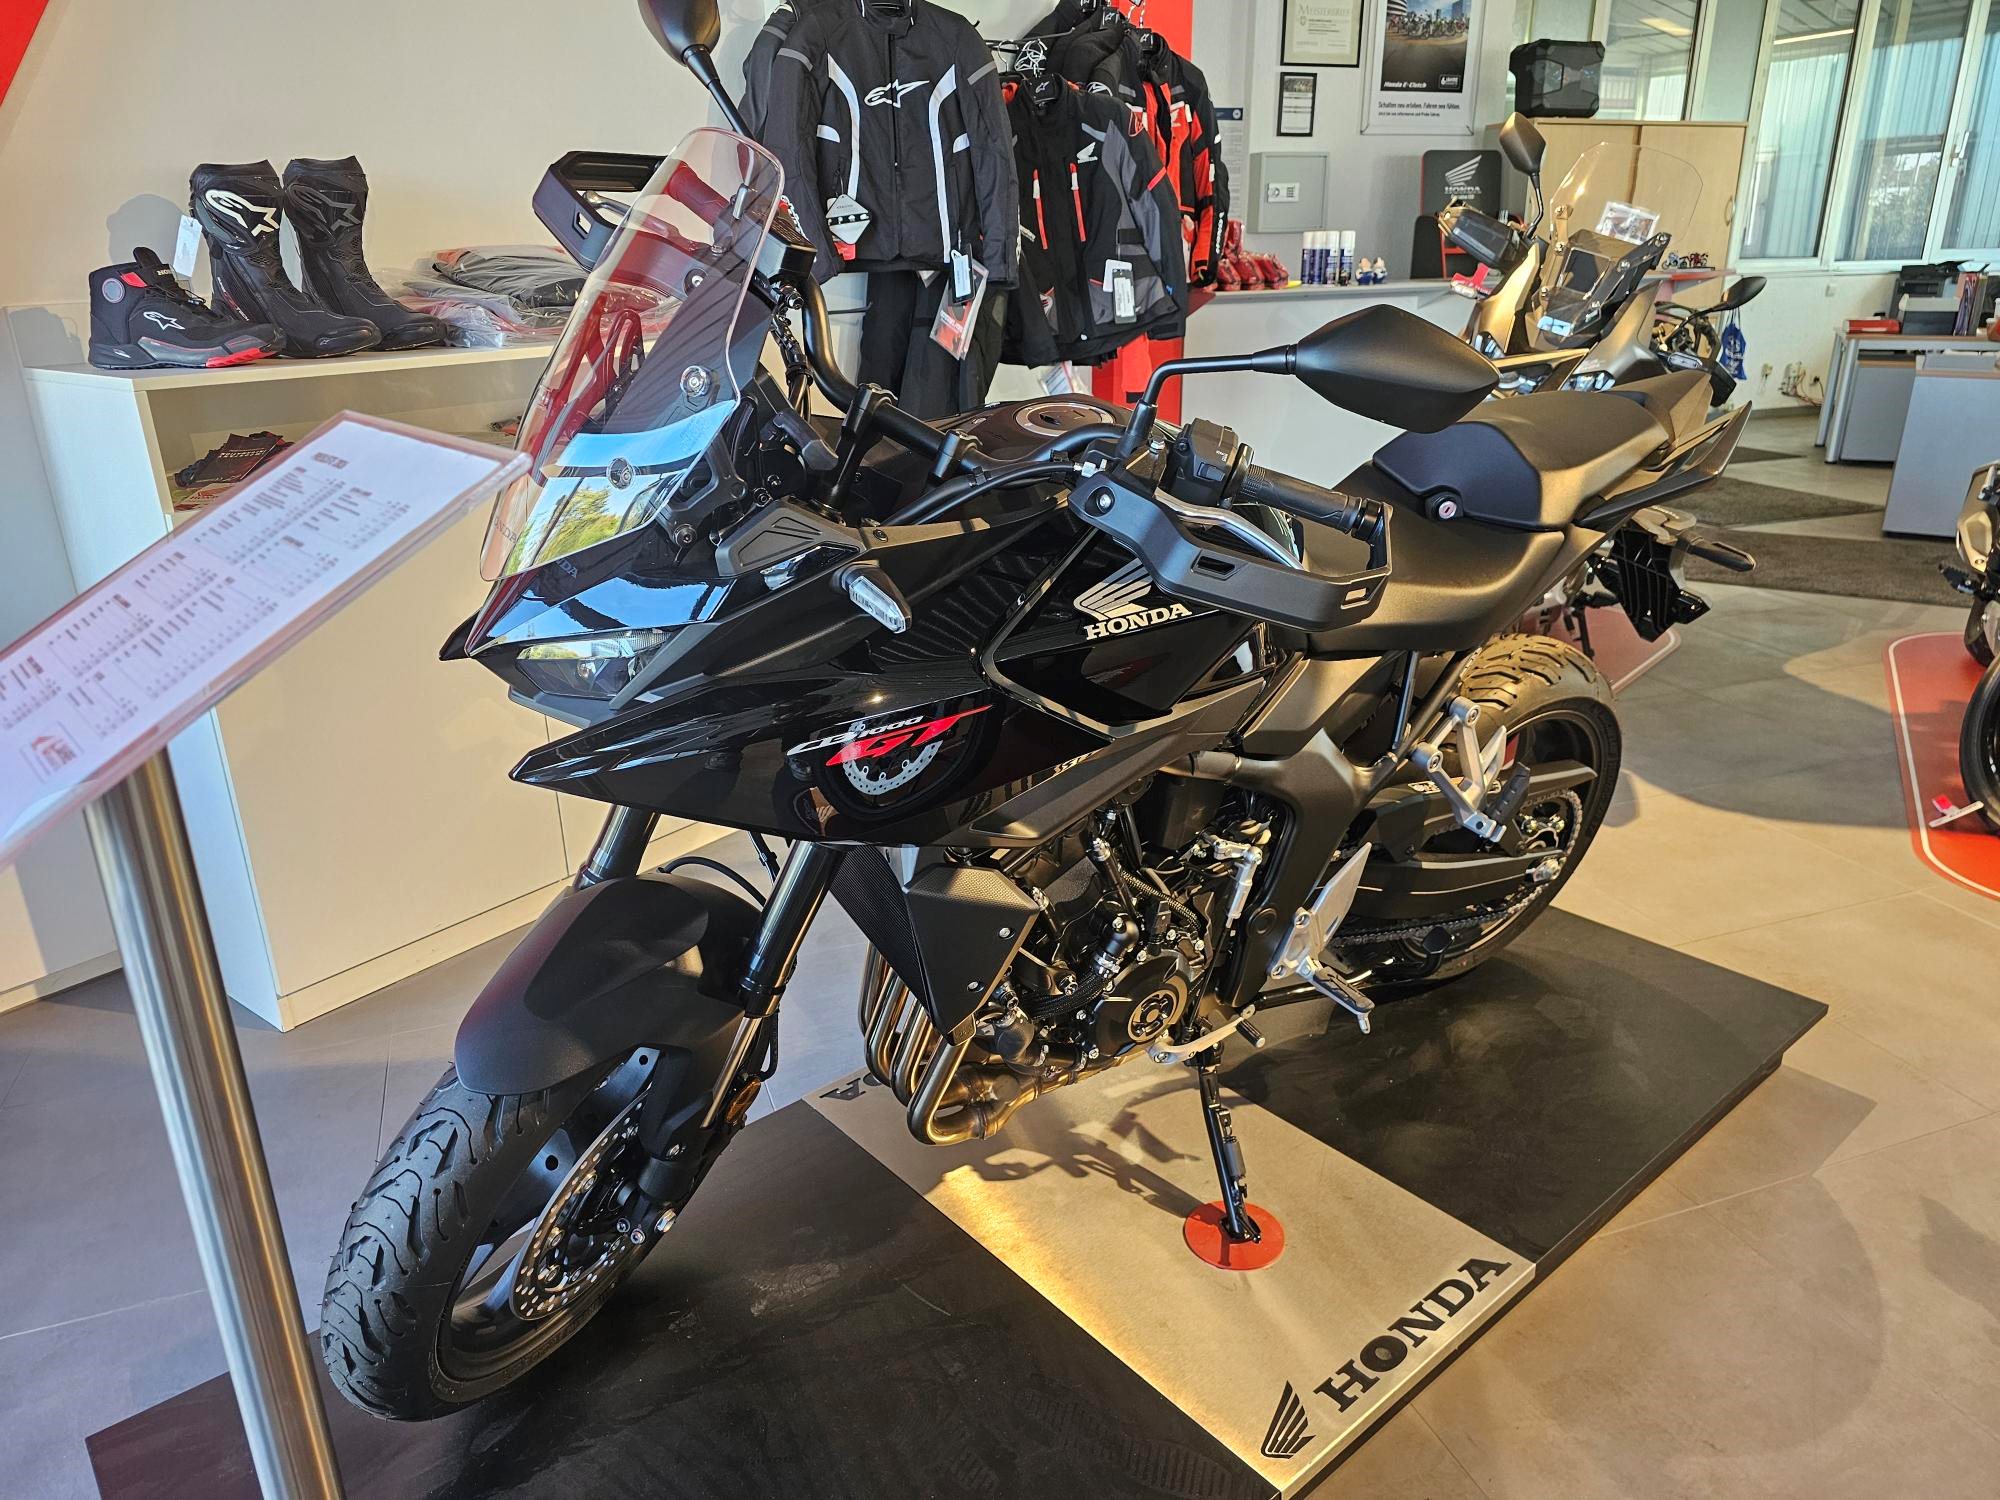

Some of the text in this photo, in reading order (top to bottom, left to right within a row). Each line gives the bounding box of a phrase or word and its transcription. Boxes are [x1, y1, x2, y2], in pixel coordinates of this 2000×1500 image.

[1378, 101, 1396, 109] Schalten
[1444, 186, 1482, 194] HONDA
[1083, 602, 1193, 640] HONDA
[1313, 1257, 1512, 1414] HONDA
